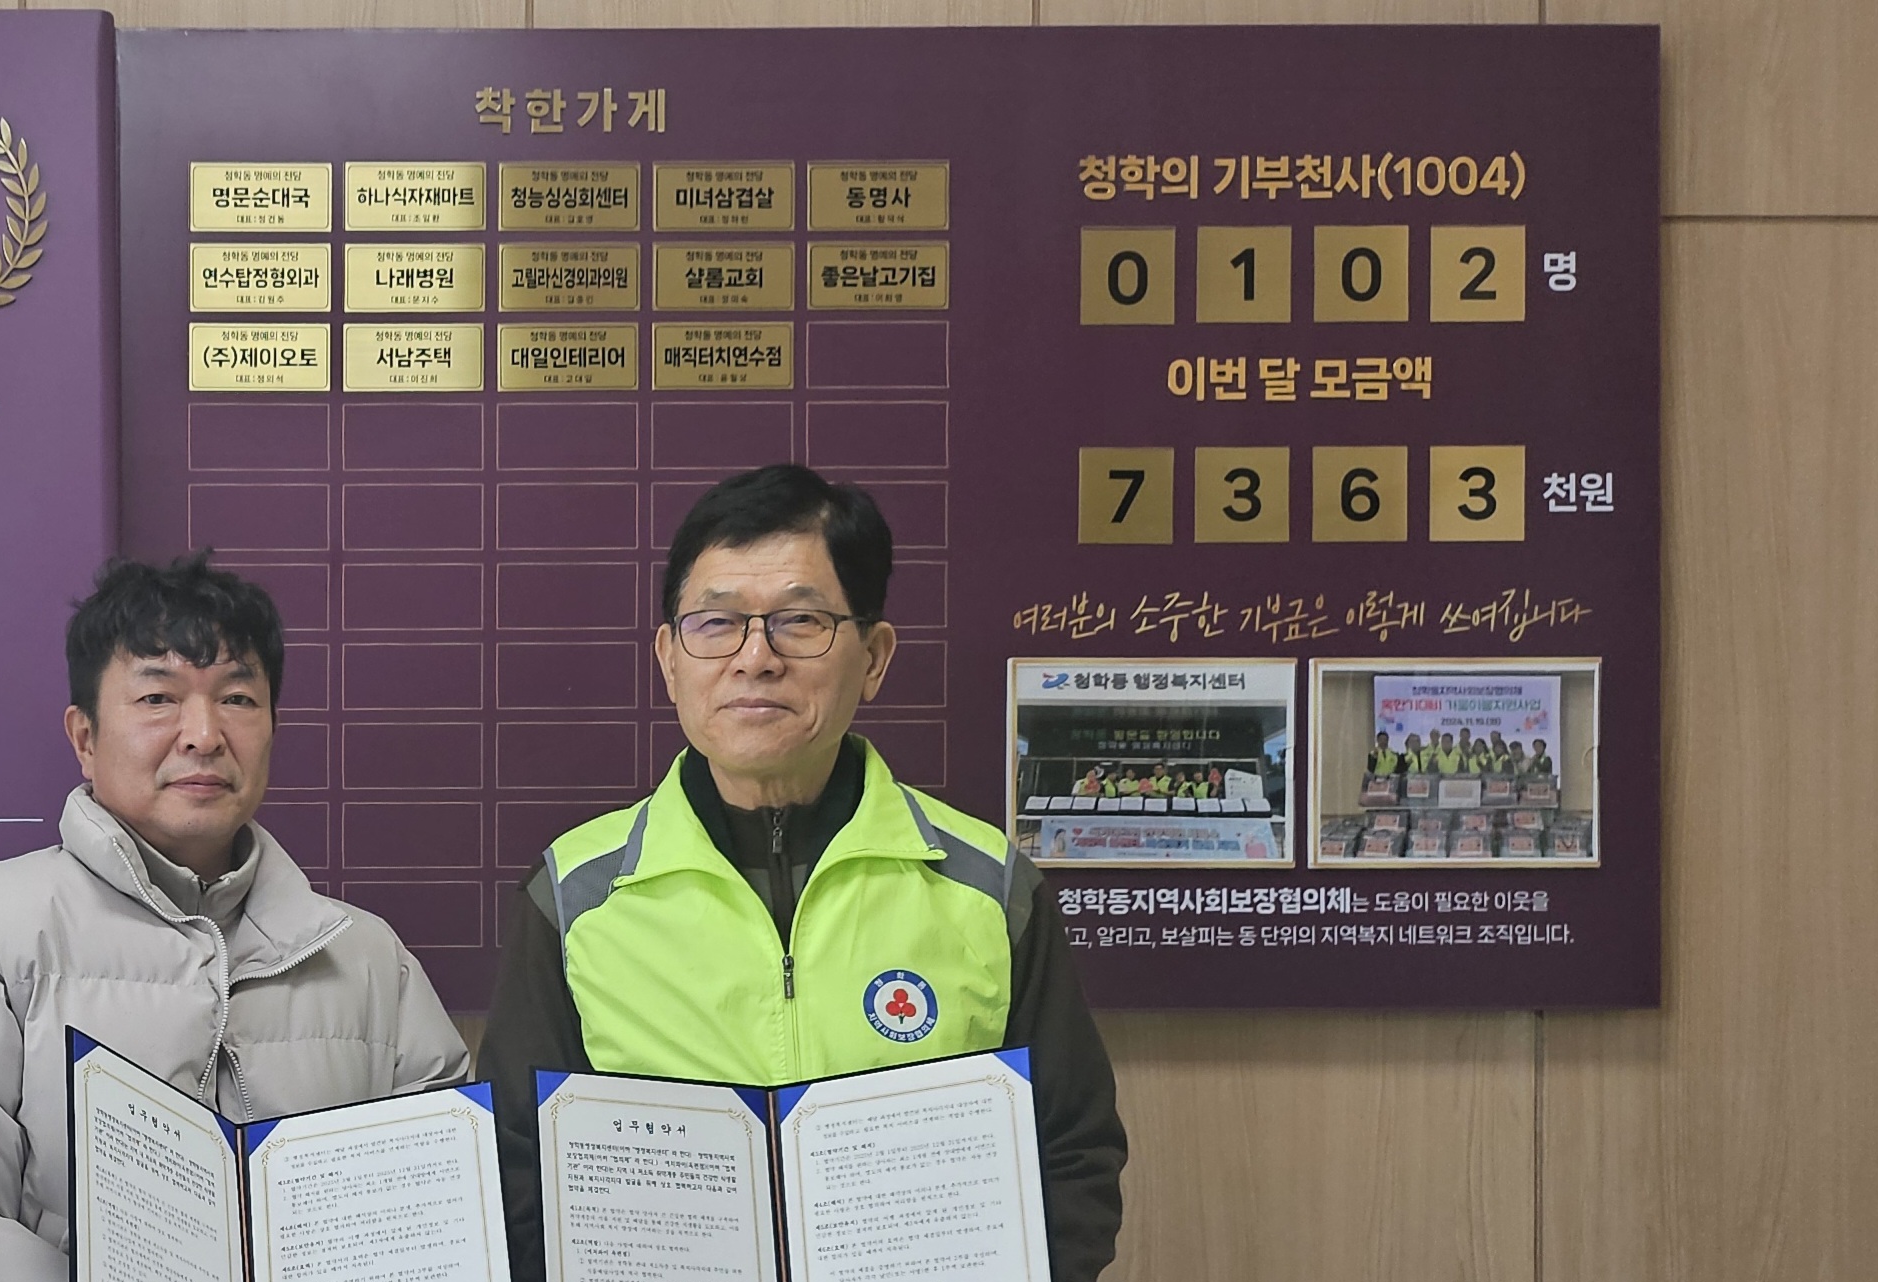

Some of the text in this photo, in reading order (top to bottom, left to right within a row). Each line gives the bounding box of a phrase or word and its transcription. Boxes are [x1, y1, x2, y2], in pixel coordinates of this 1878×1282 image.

[474, 85, 667, 135] 착한가게
[1078, 151, 1526, 201] 청학의 기부천사(1004)
[213, 187, 310, 208] 명문순대국
[357, 187, 475, 206] 하나식자재마트
[846, 187, 911, 208] 동명사
[203, 268, 319, 288] 연수탑정형외과
[376, 268, 453, 288] 나래병원
[512, 267, 628, 289] 고릴라신경외과의원
[686, 267, 763, 288] 샬롬교회
[821, 266, 936, 287] 좋은날고기집
[1108, 247, 1577, 305] 0 1 0 2 명
[204, 346, 318, 368] (주)제이오토
[377, 347, 451, 368] 서남주택
[512, 346, 624, 368] 대일인테리어
[665, 346, 781, 368] 매직터치연수점
[1167, 357, 1433, 401] 이번 달 모금액
[1108, 467, 1615, 523] 7 3 6 3 천원
[1013, 589, 1593, 643] 여러분의 소중한 기부금은 이렇게 쓰여집니다
[1074, 673, 1246, 690] 청학동 행정복지센터
[1058, 887, 1549, 915] 청학동지역사회보장협의체는 도움이 필요한 이웃을
[1065, 924, 1575, 949] 고, 알리고, 보살피는 동 단위의 지역복지 네트워크 조직입니다.
